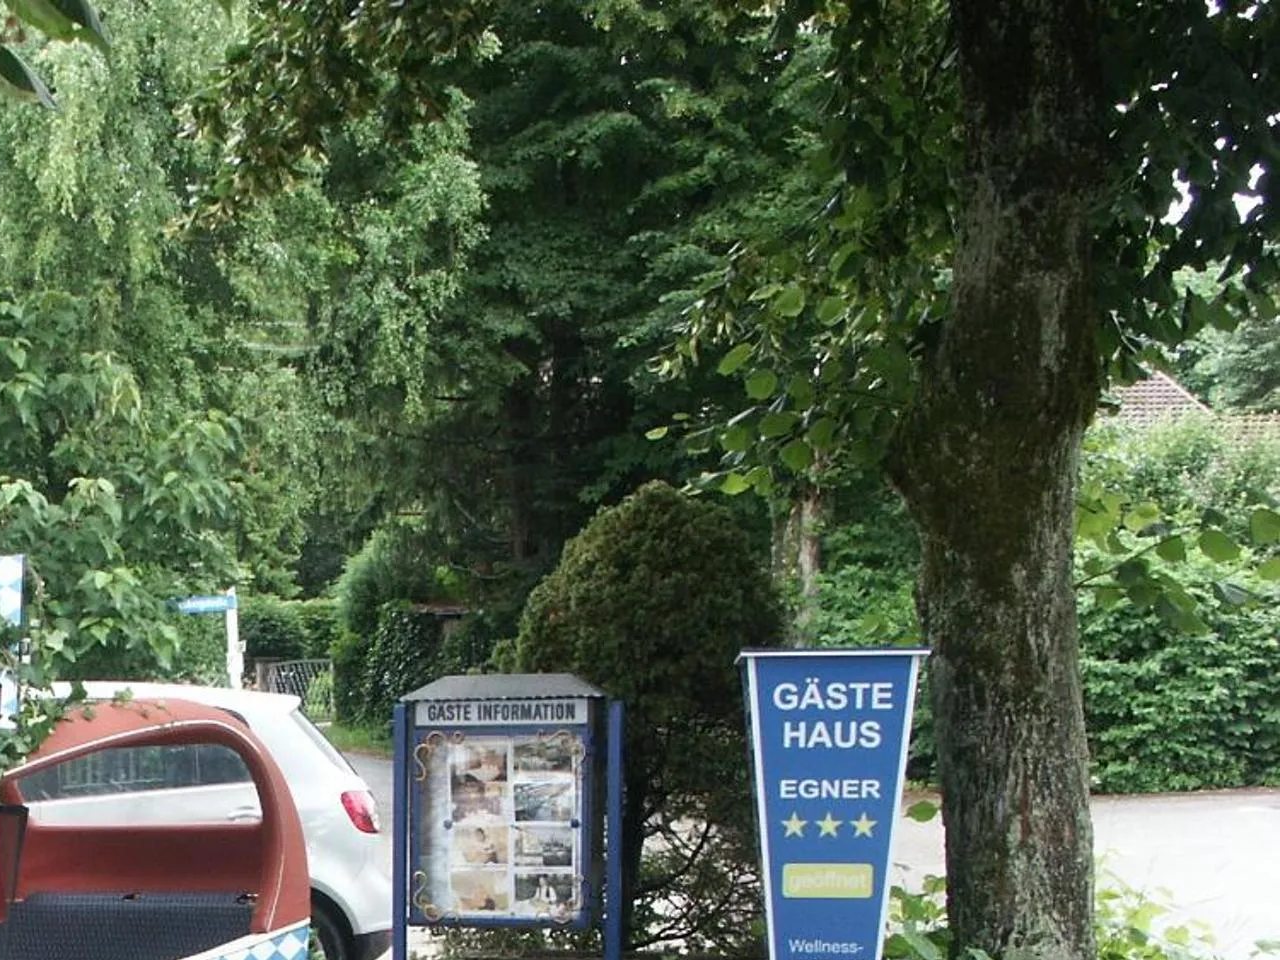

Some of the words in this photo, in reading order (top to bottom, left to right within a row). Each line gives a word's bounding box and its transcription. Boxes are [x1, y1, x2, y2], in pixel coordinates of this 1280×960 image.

[773, 677, 893, 710] GÄSTE
[477, 701, 576, 721] INFORMATION
[783, 721, 881, 748] HAUS
[780, 779, 880, 799] EGNER
[788, 939, 864, 954] Wellness-
